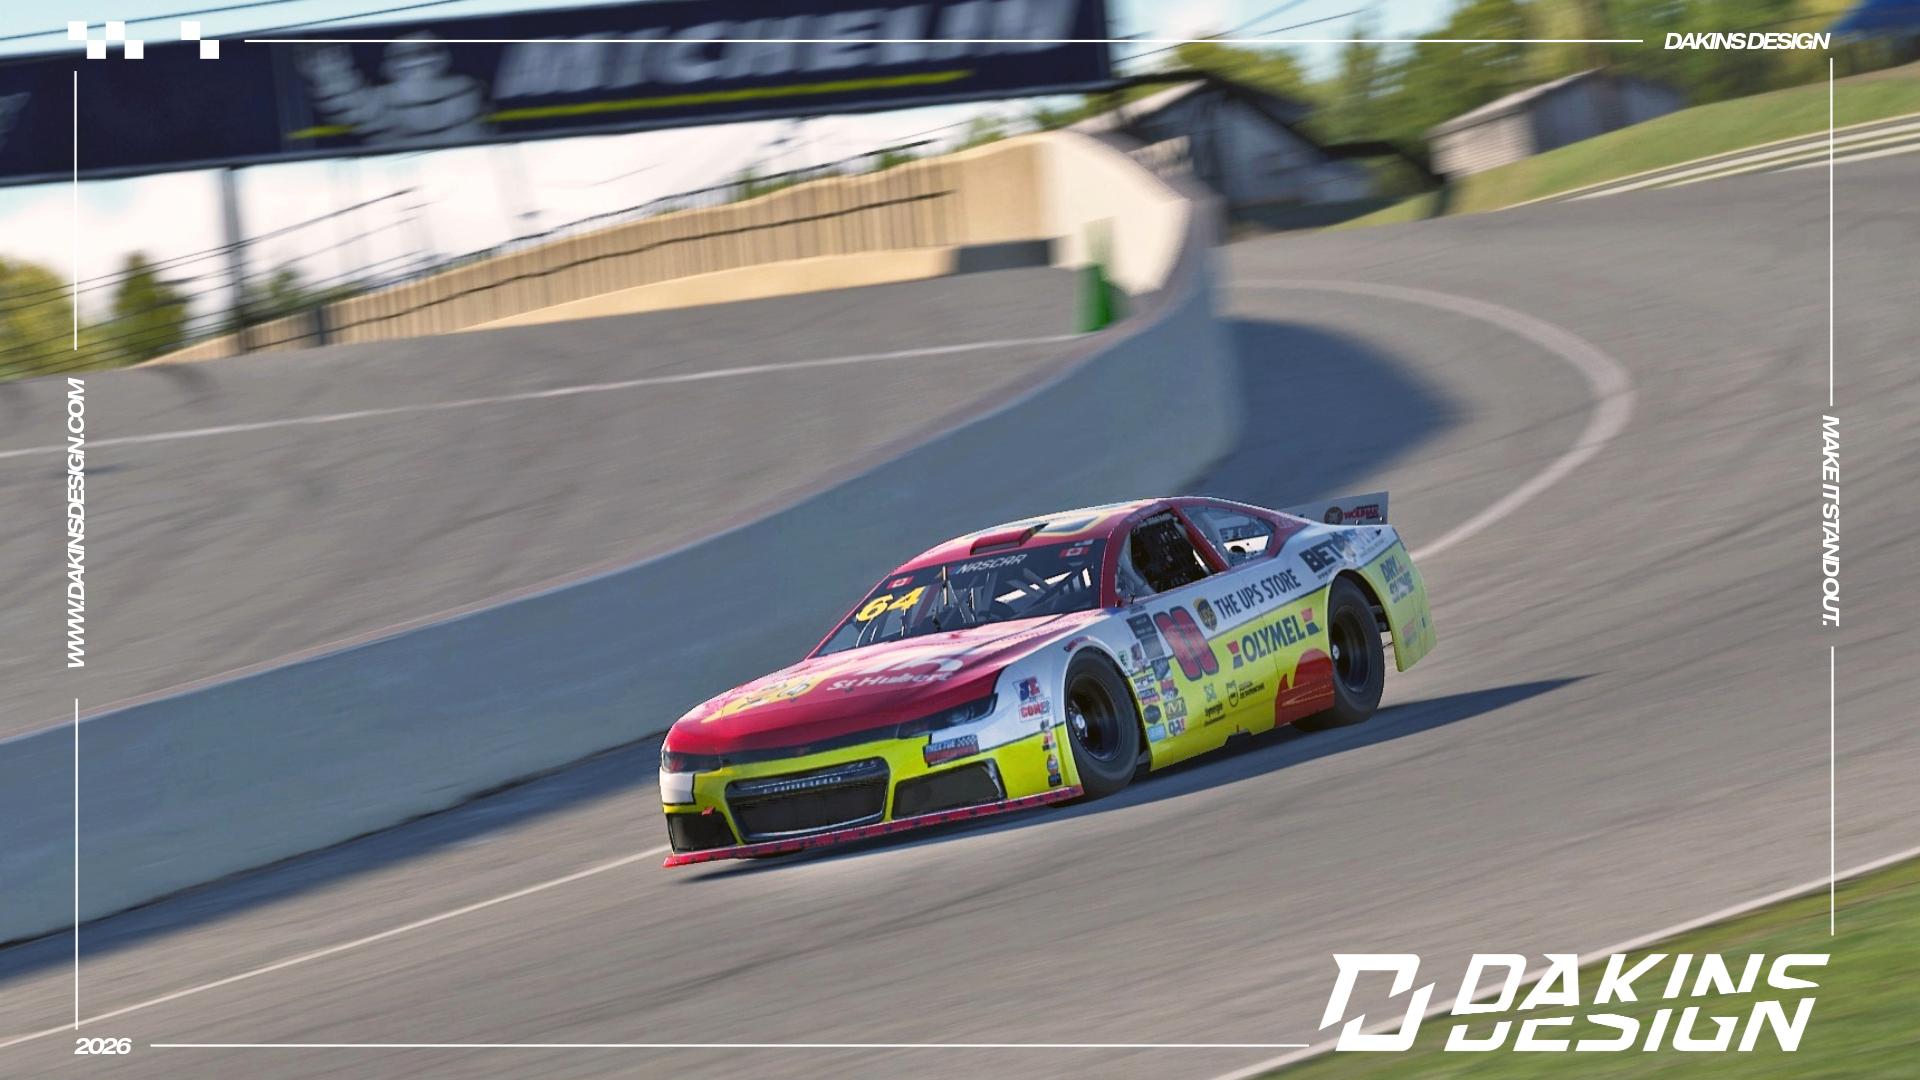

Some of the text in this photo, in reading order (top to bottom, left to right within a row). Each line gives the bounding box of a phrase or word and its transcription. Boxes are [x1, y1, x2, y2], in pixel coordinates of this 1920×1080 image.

[492, 0, 1082, 98] MICHELIN
[955, 554, 1027, 574] NASCAR
[856, 585, 926, 622] 64
[1214, 594, 1242, 619] THE
[1236, 584, 1264, 609] UPS
[1260, 568, 1301, 599] STORE
[1242, 615, 1306, 662] OLYMEL
